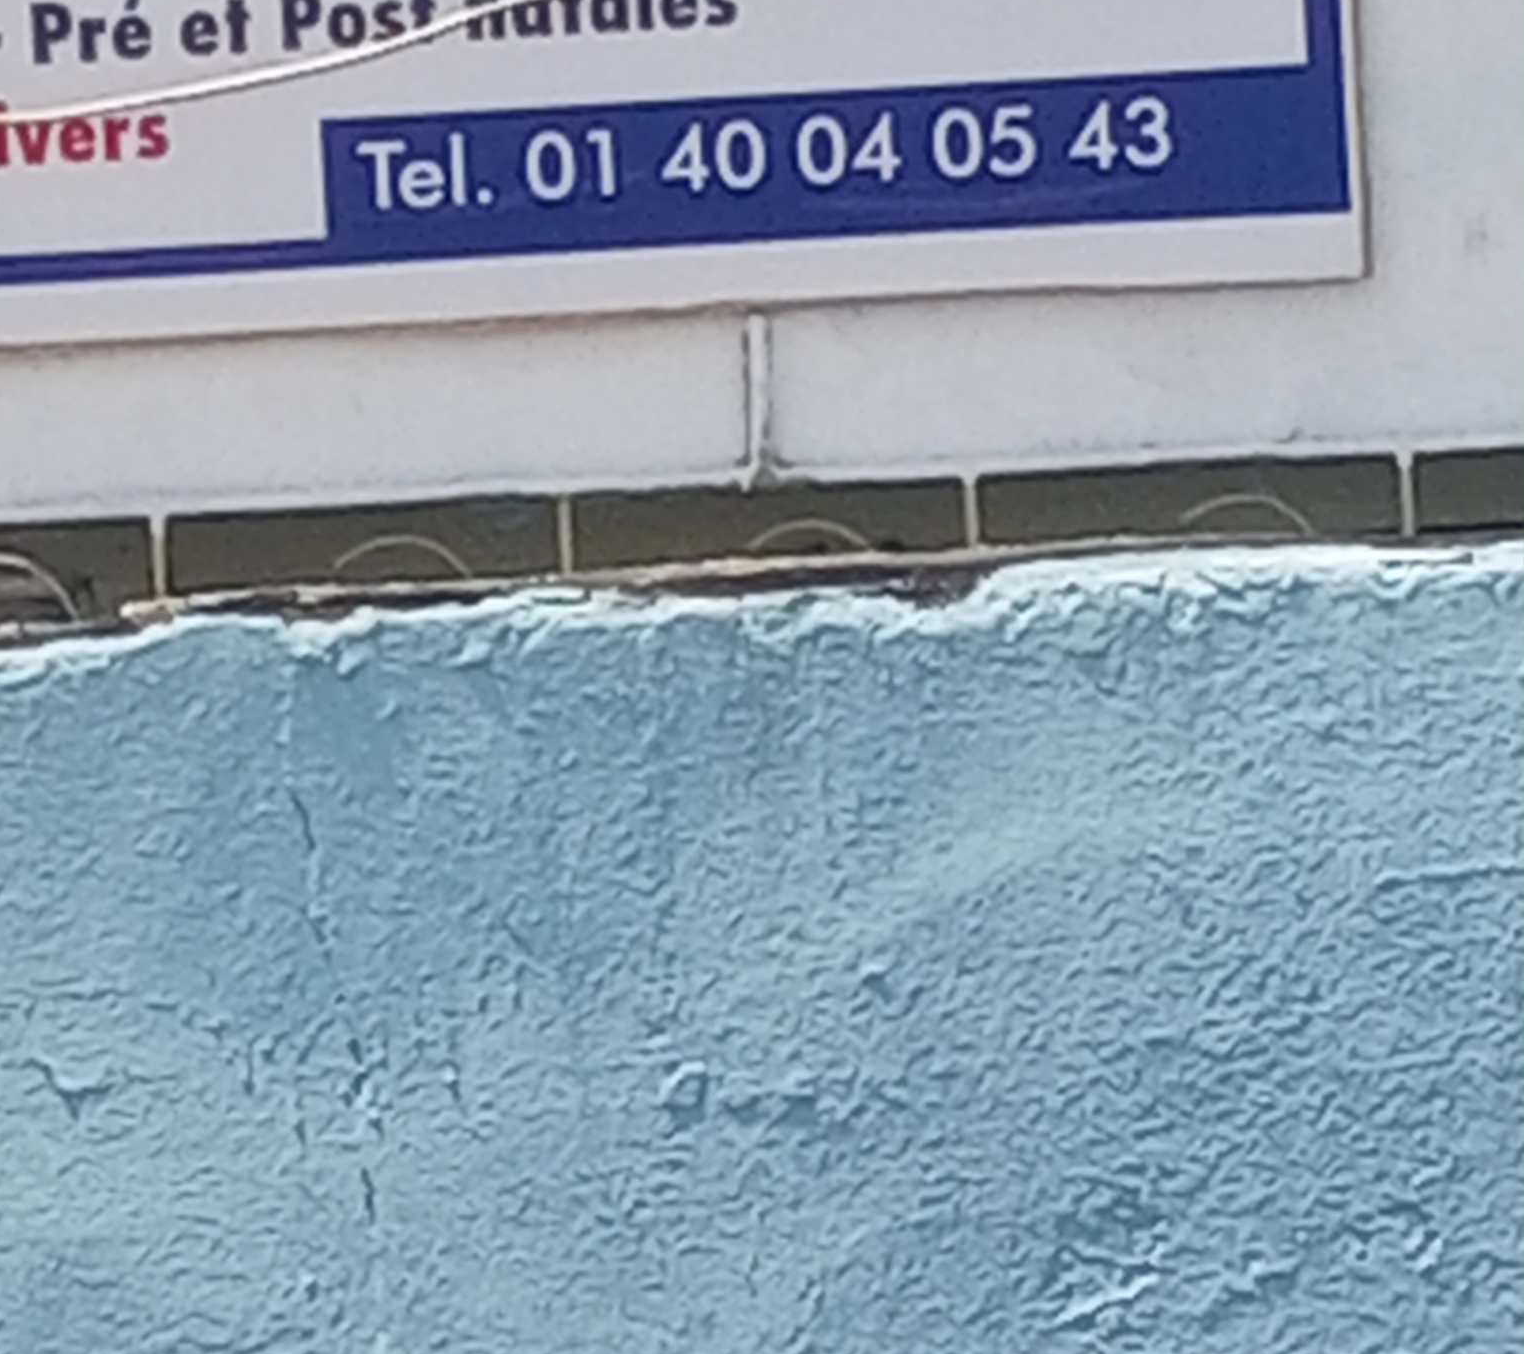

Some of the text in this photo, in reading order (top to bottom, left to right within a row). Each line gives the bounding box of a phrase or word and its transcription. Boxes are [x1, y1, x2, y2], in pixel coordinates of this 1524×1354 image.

[356, 96, 1172, 210] Tel. 01 40 04 05 43
